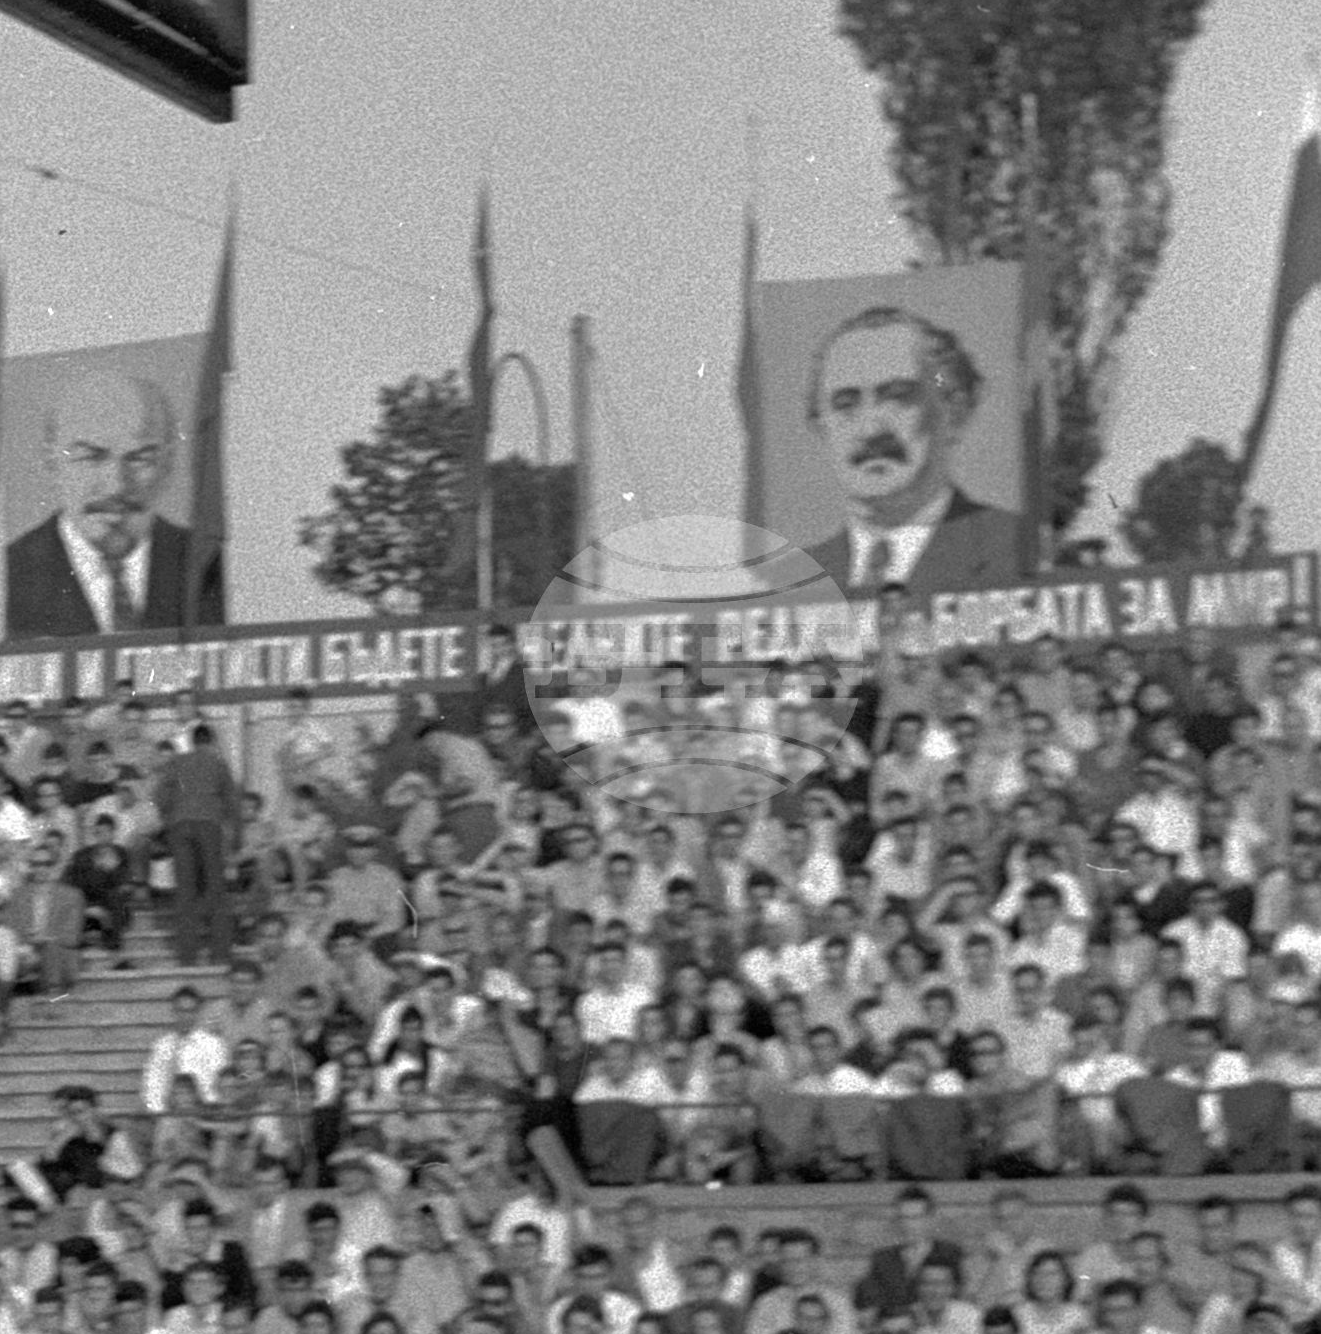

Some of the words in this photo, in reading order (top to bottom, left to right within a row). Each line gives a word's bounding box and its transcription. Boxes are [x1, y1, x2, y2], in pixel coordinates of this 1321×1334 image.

[320, 626, 465, 687] БЪДЕТЕ
[931, 583, 1113, 651] БОРБАТА
[1118, 577, 1179, 635] ЗА
